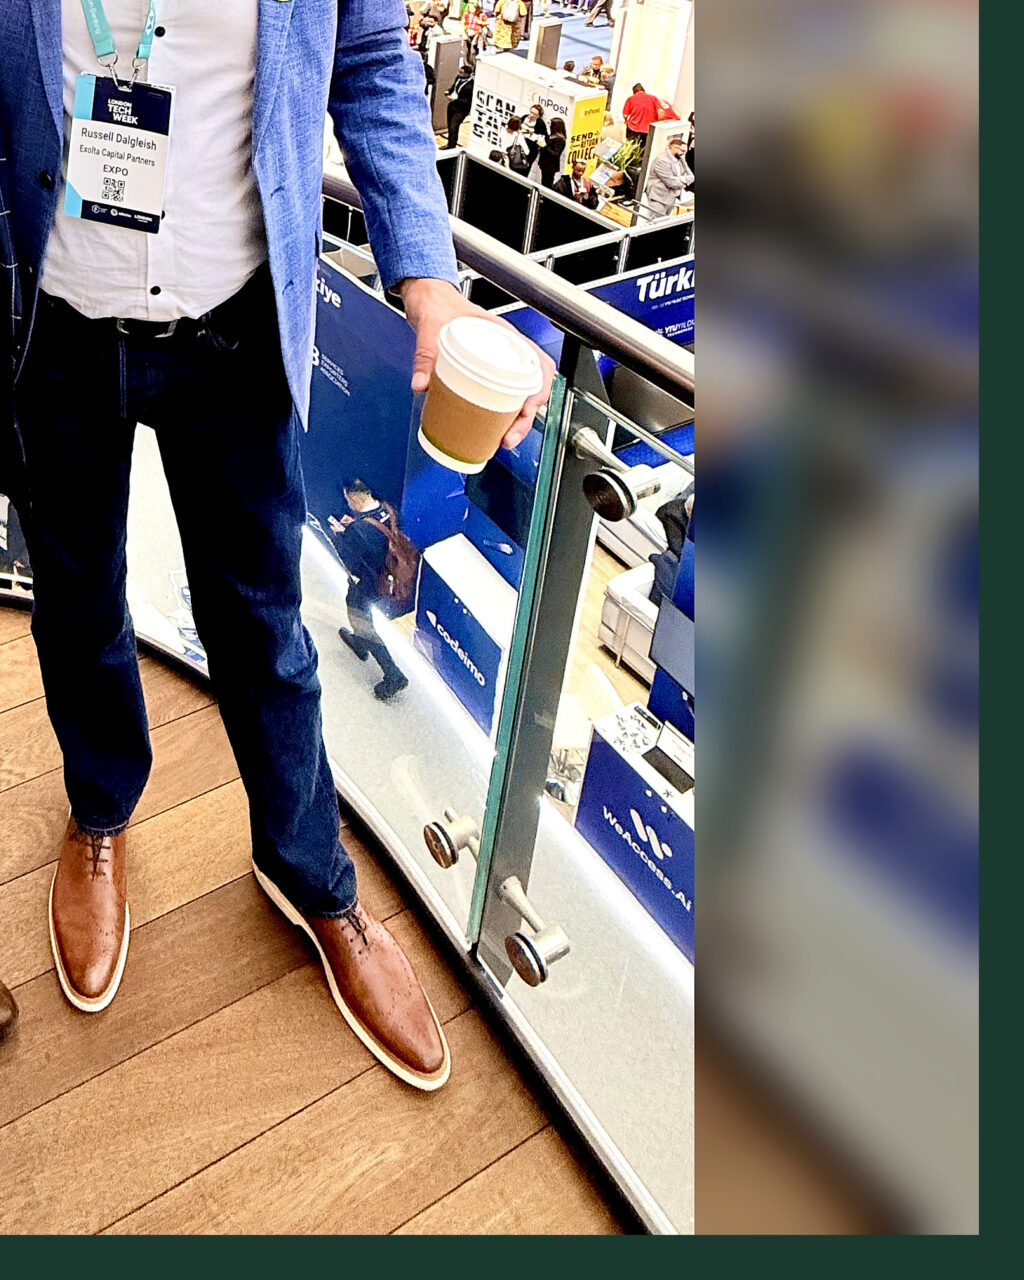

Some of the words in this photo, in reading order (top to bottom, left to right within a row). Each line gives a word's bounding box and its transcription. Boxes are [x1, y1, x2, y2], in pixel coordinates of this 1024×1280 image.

[108, 98, 133, 108] LONDON
[108, 104, 132, 115] TECH
[538, 95, 569, 116] InPost
[112, 112, 138, 125] WEEK
[81, 127, 114, 142] Russell
[116, 133, 157, 151] Dalgleish
[571, 132, 593, 143] SEND
[102, 148, 126, 161] Capital
[126, 153, 156, 167] Partners
[103, 164, 129, 177] EXPO
[437, 624, 486, 687] codeimo
[603, 805, 692, 912] WeAccess.Ai
